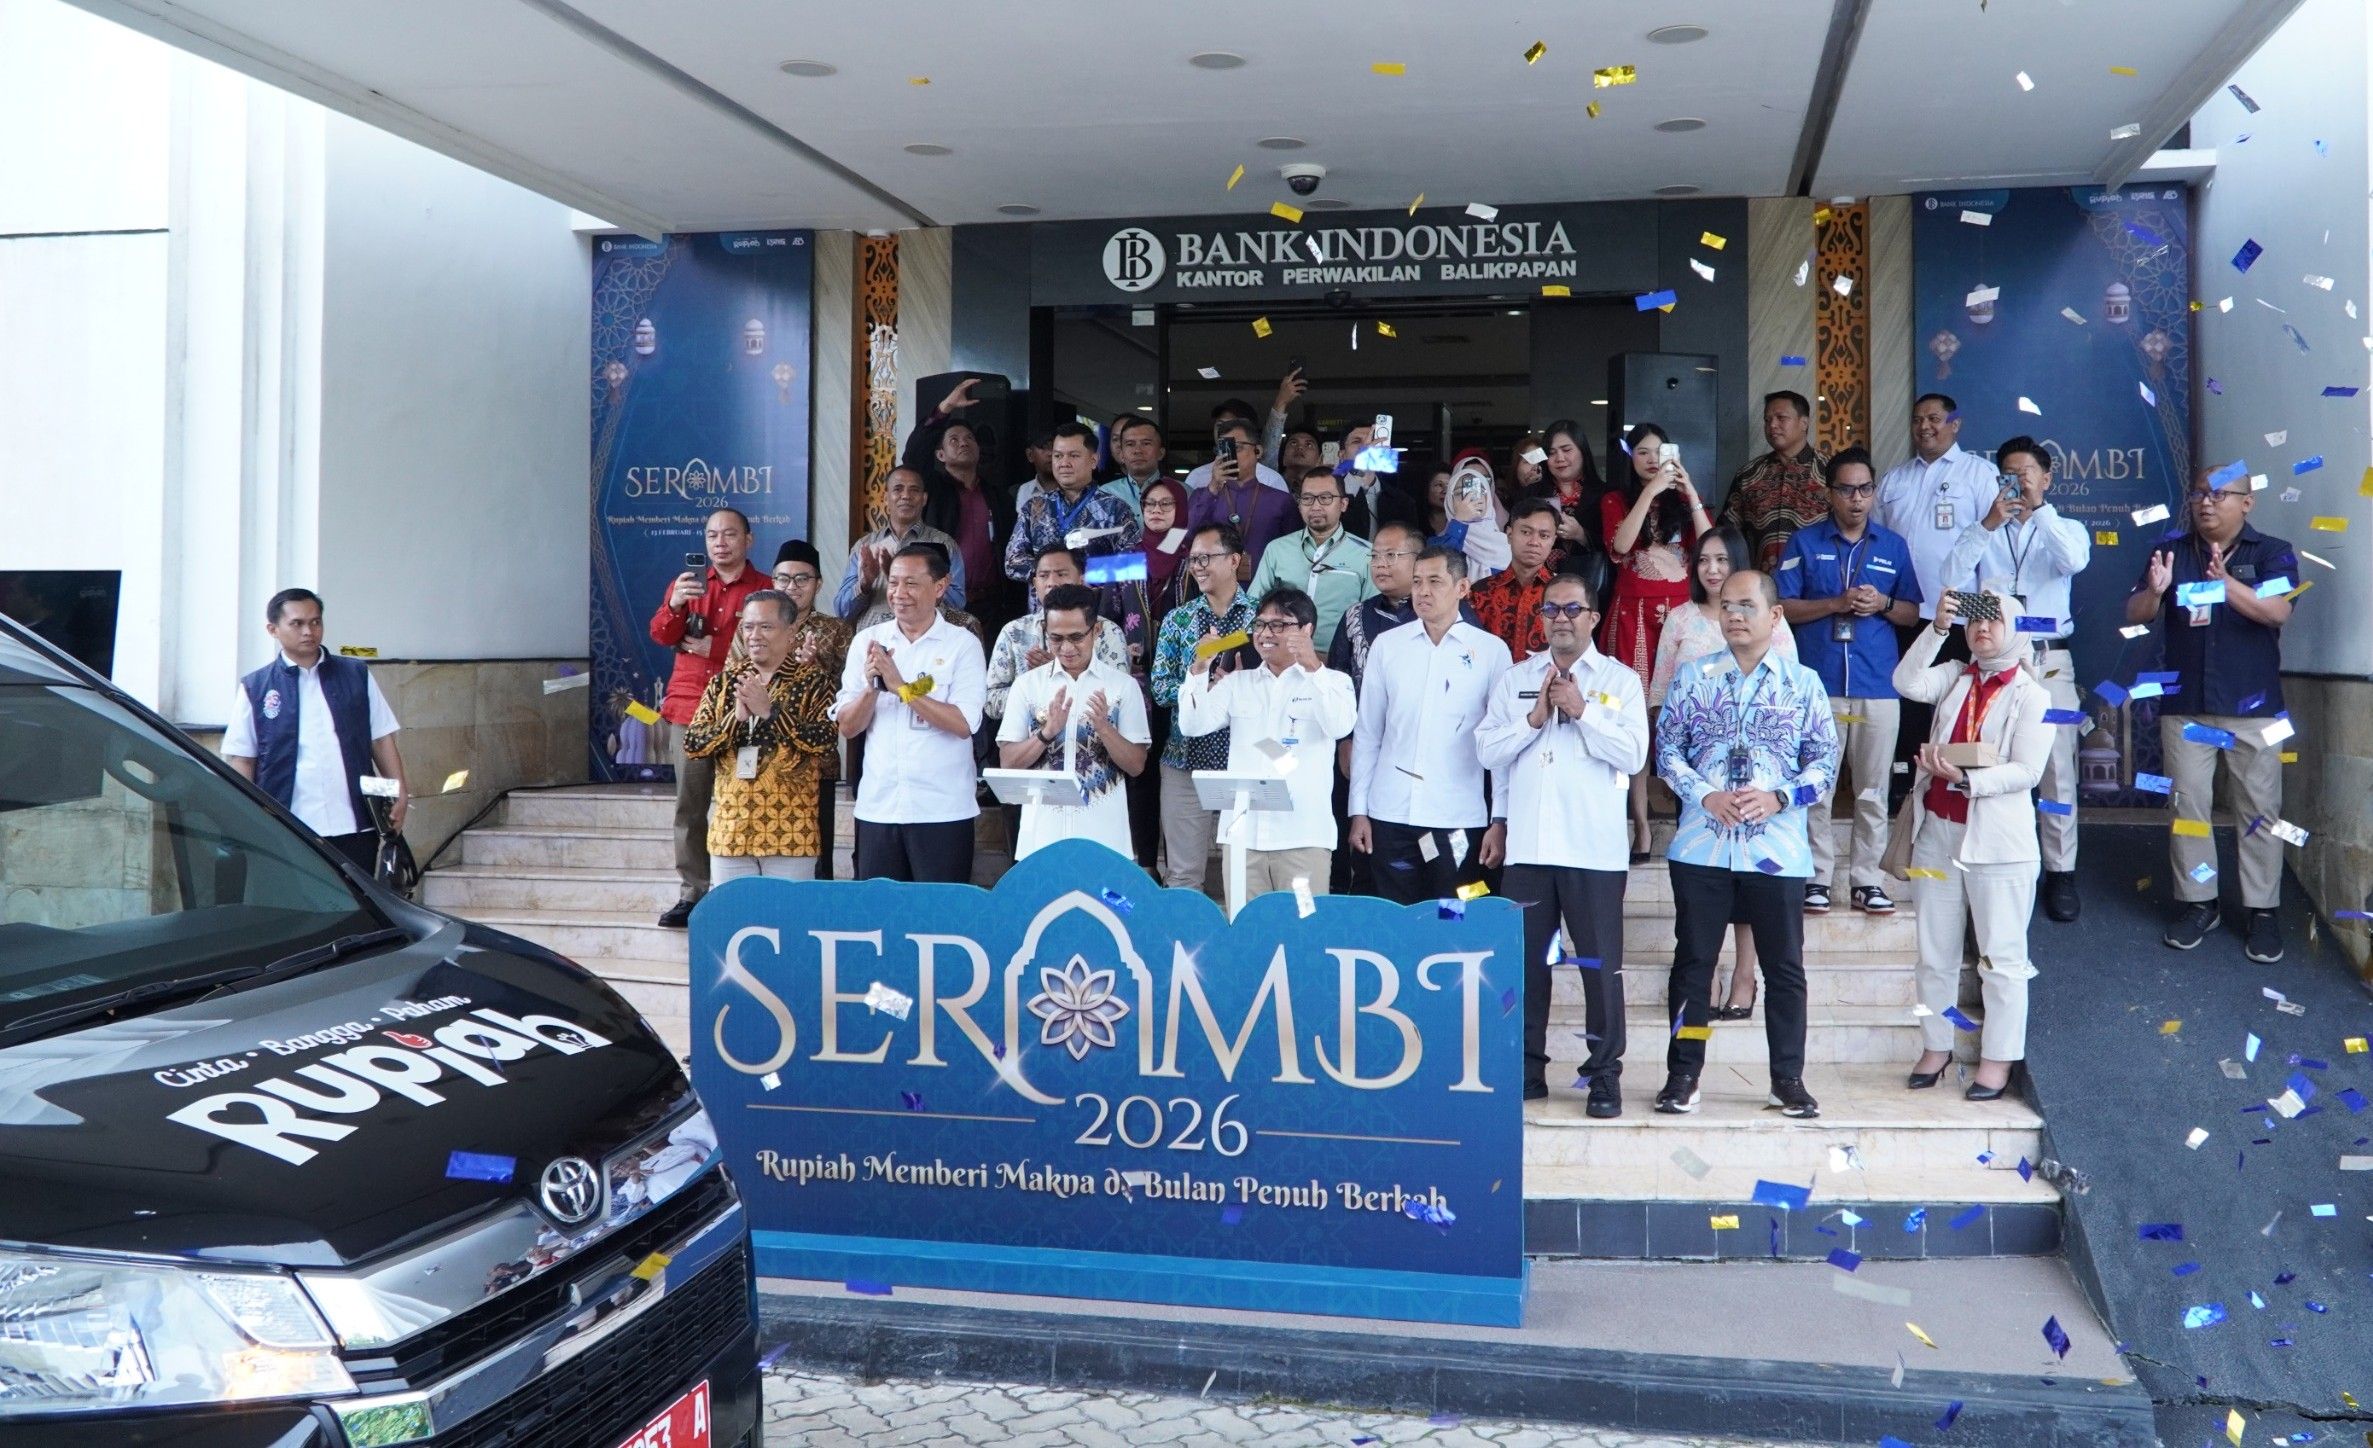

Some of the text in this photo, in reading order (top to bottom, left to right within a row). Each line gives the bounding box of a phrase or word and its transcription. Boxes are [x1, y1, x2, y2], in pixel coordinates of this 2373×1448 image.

[1176, 220, 1577, 266] BANK INDONESIA
[1176, 260, 1577, 288] KANTOR PERWAKILAN BALIKPAPAN
[625, 458, 773, 500] SERAMBI
[696, 496, 729, 508] 2026
[2049, 481, 2090, 496] 2026
[713, 889, 1496, 1106] SERAMBI
[153, 993, 472, 1088] Cinta Bangga Paham
[165, 1008, 613, 1166] Rupiah
[1073, 1093, 1250, 1157] 2026
[756, 1150, 856, 1185] Rupiah
[863, 1151, 988, 1188] Memberi
[994, 1158, 1095, 1198] Makna
[1141, 1170, 1226, 1204] Bulan
[1233, 1176, 1328, 1211] Penuh
[694, 1391, 707, 1439] A
